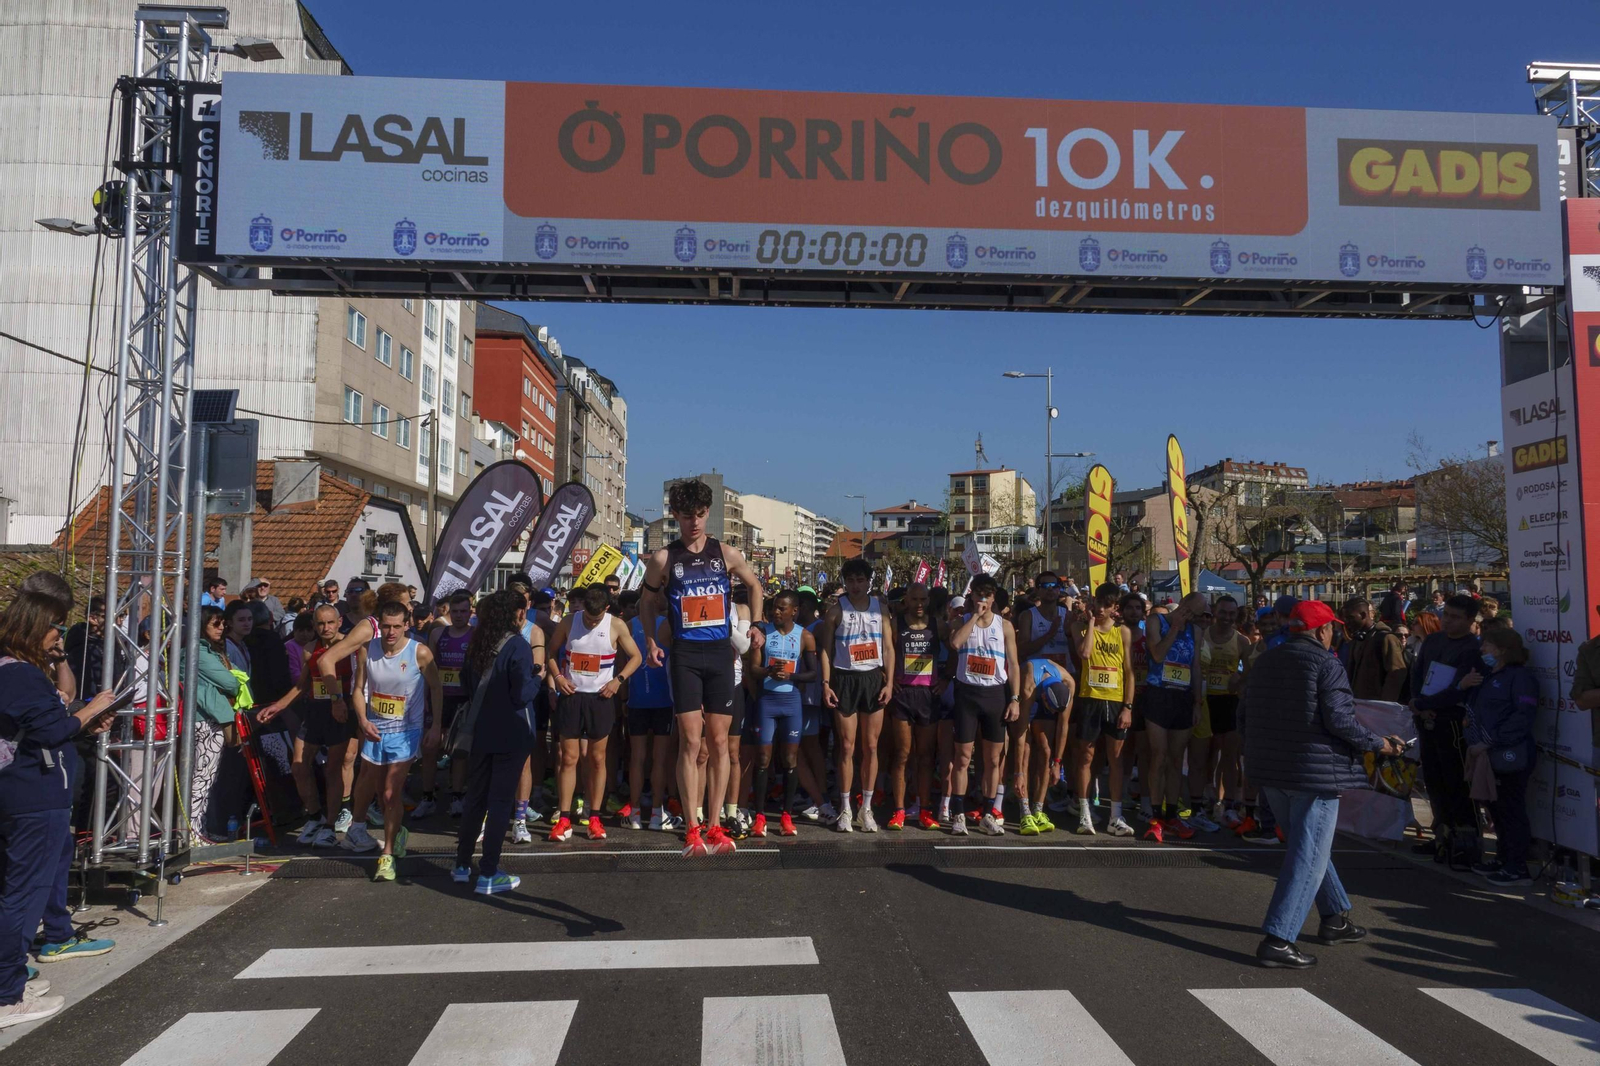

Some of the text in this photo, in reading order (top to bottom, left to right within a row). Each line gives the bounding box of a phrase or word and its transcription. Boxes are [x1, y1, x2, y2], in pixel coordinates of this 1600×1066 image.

[300, 111, 489, 166] LASAL
[642, 106, 1003, 186] PORRIÑO
[1024, 127, 1214, 191] 10K.
[422, 167, 489, 183] cocinas
[1348, 146, 1534, 199] GADIS
[1035, 196, 1216, 222] dezquilómetros
[296, 228, 347, 244] Porriño
[439, 232, 490, 247] Porriño
[580, 236, 630, 251] Porriño
[756, 229, 928, 267] 00:00:00
[990, 246, 1036, 260] Porriño
[1122, 249, 1168, 263] Porriño
[1252, 253, 1298, 266] Porriño
[1380, 256, 1426, 269] Porriño
[1507, 258, 1552, 271] Porriño
[1523, 397, 1567, 425] LASAL
[1514, 438, 1567, 468] GADIS
[1523, 481, 1556, 495] RODOSA
[508, 495, 533, 528] cocinas
[574, 505, 589, 530] cocinas
[1529, 510, 1568, 524] ELECPOR
[448, 490, 525, 579] LASAL
[534, 502, 582, 570] LASAL
[1524, 550, 1543, 559] Grupo
[1540, 559, 1567, 567] Macera
[1523, 595, 1559, 606] NaturGas
[699, 605, 708, 620] 4
[854, 649, 875, 662] 2003
[580, 660, 590, 671] 12
[914, 661, 924, 671] 27
[971, 662, 991, 675] 2001
[444, 673, 454, 683] 67
[1098, 673, 1110, 684] 88
[1171, 669, 1183, 680] 32
[378, 701, 395, 715] 108
